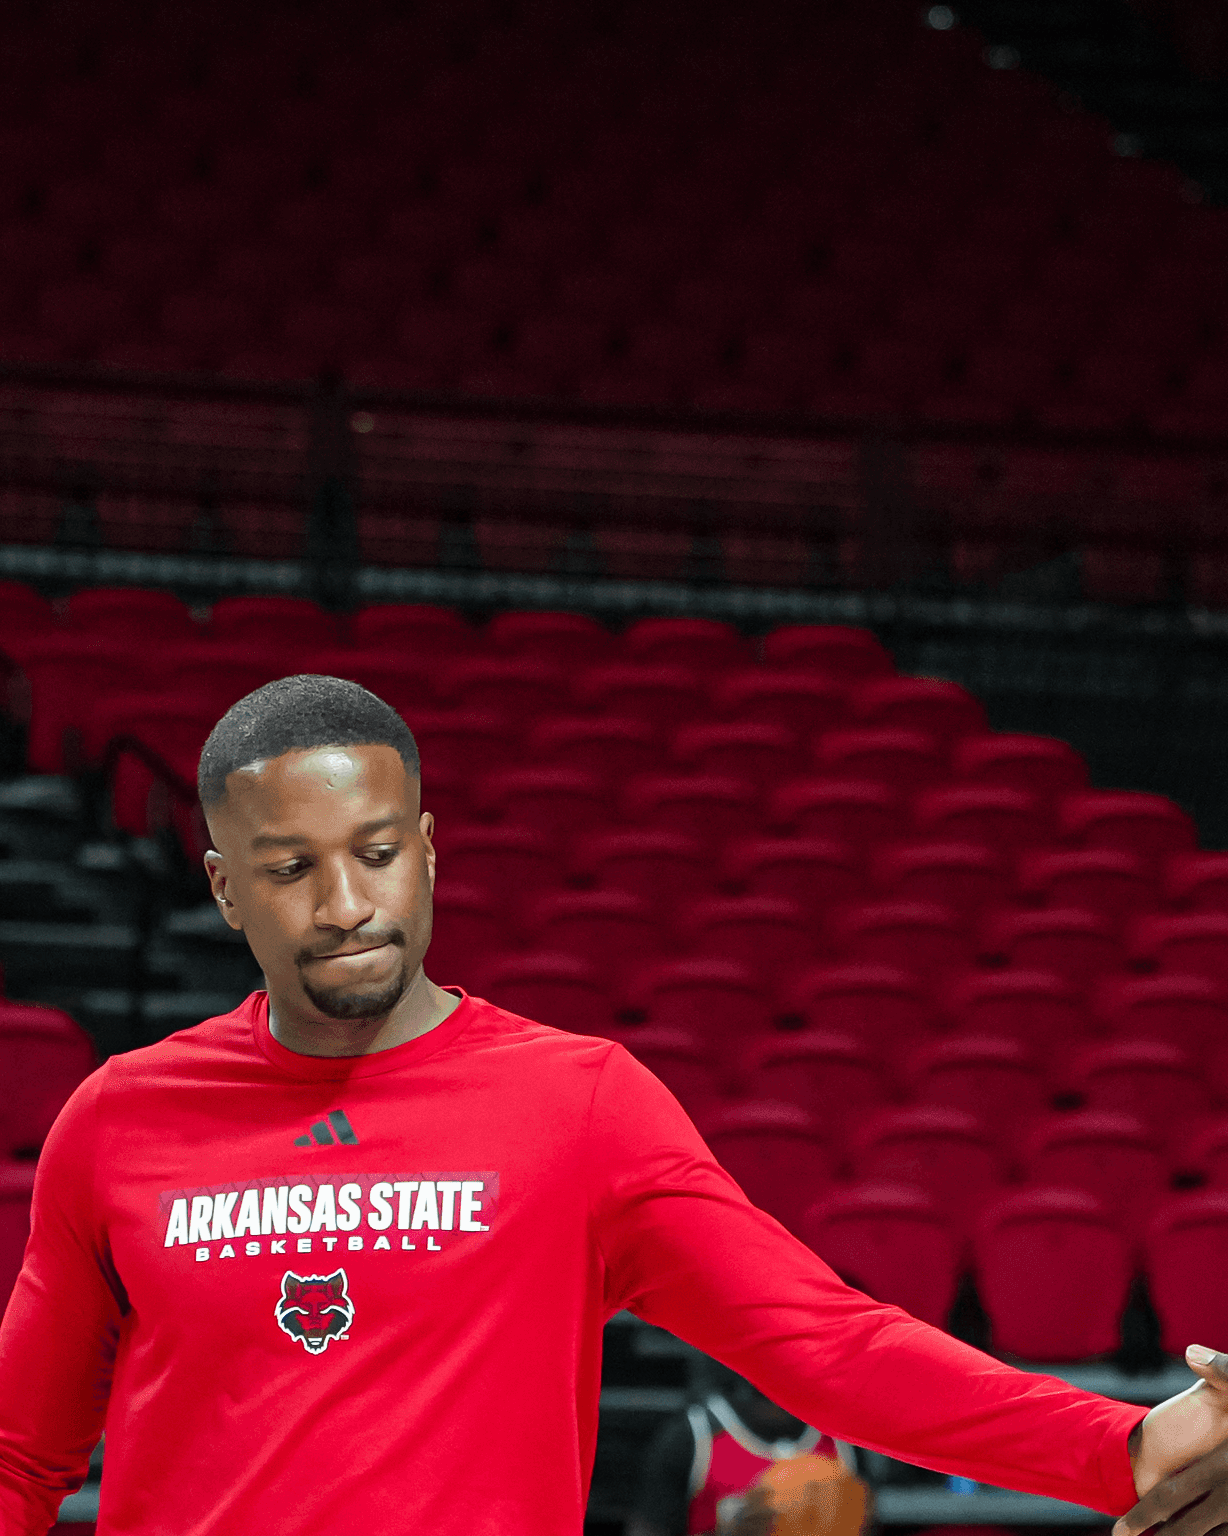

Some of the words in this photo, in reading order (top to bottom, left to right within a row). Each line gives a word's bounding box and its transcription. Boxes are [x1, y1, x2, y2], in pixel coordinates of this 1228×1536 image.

[164, 1183, 362, 1248] ARKANSAS
[367, 1181, 484, 1232] STATE
[195, 1236, 441, 1262] BASKETBALL
